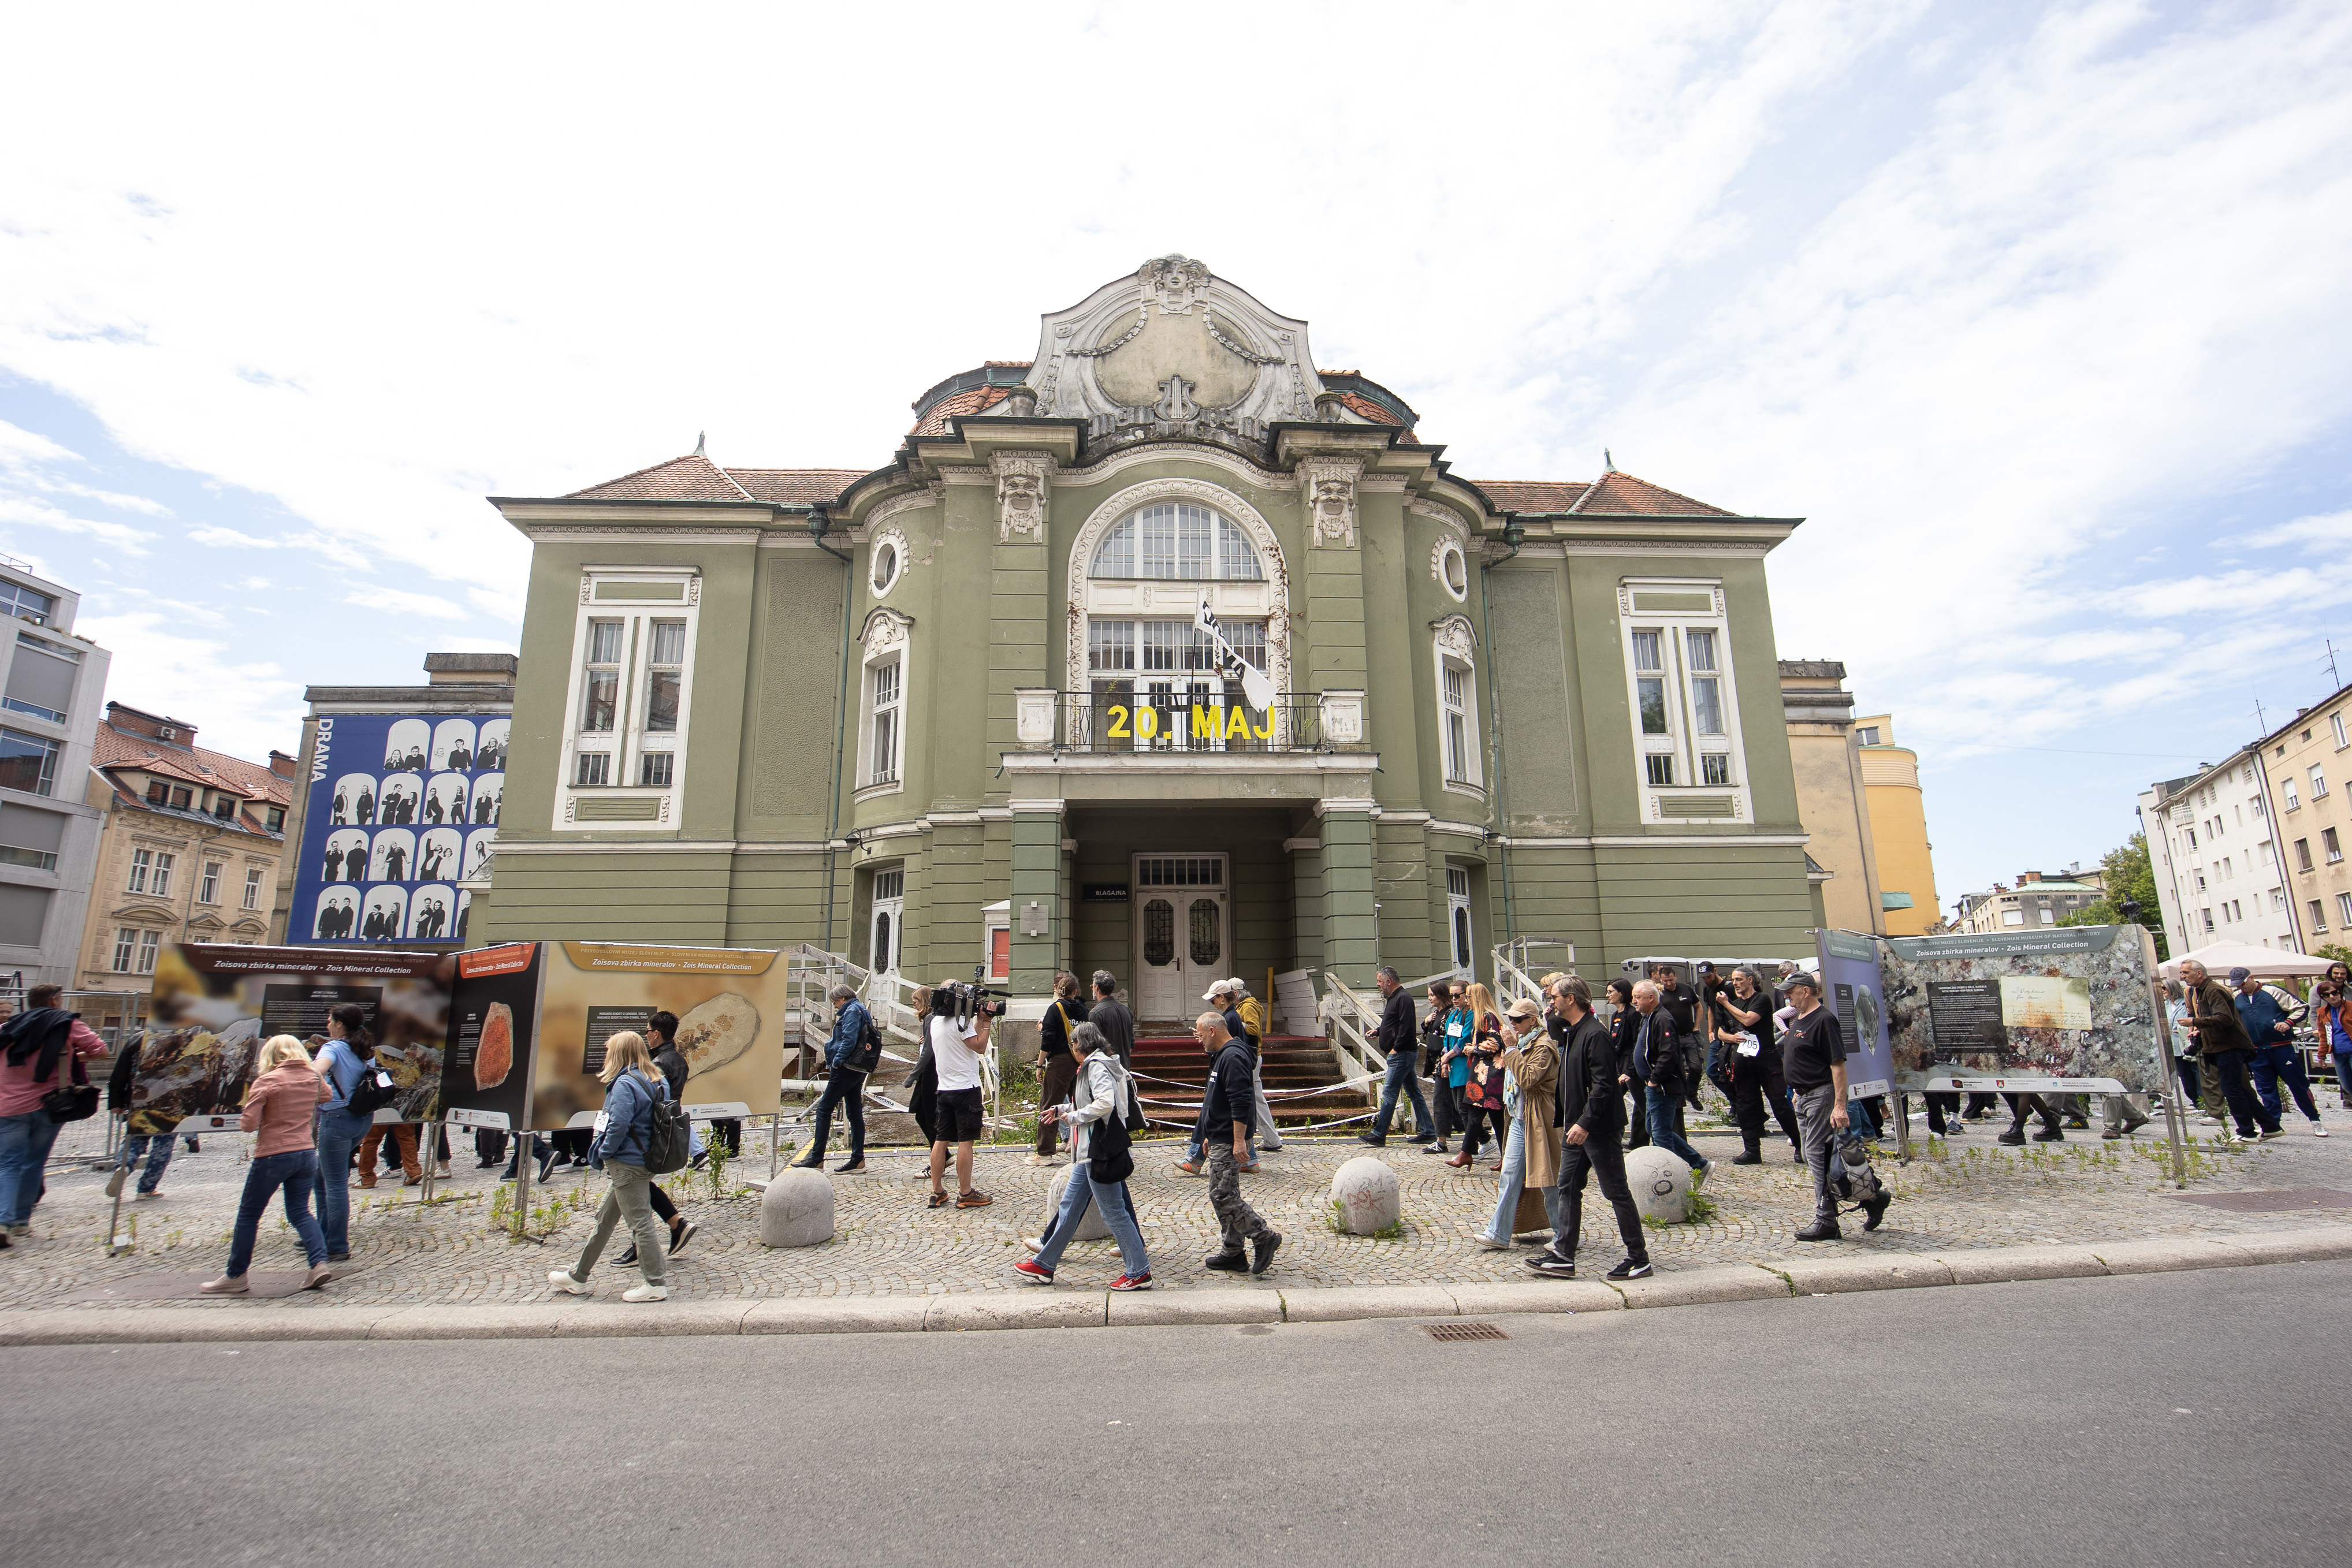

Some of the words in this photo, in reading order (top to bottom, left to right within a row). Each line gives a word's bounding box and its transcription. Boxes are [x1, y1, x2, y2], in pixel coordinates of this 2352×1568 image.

[1108, 705, 1171, 739] 20.
[1192, 705, 1275, 739] MAJ
[311, 719, 334, 783] DRAMA
